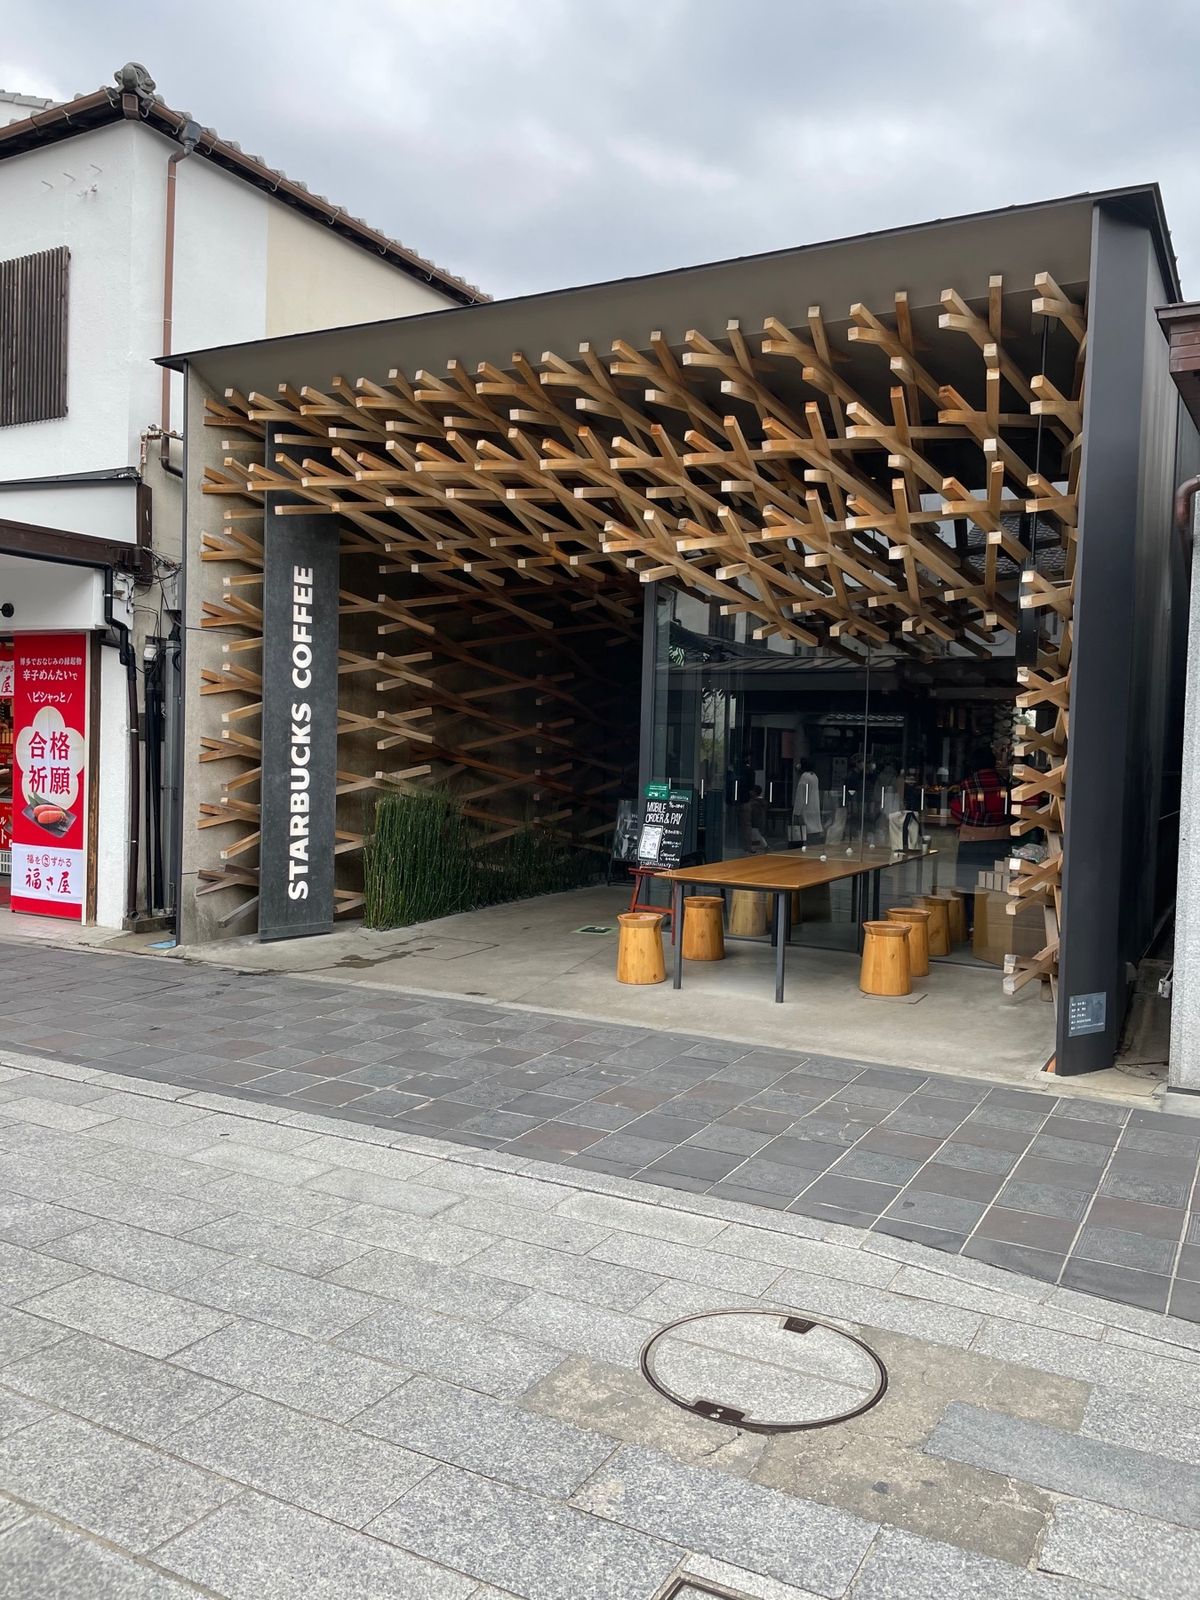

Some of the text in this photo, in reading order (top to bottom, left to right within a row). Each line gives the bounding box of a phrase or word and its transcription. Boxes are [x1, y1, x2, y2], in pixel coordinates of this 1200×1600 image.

[22, 669, 78, 681] 辛子めんたいで
[28, 731, 70, 760] 合格
[288, 566, 313, 900] STARBUCKS COFFEE
[28, 765, 70, 795] 祈願
[645, 813, 664, 823] ORDER
[670, 813, 683, 825] PAY
[646, 802, 666, 813] MOBILE
[25, 868, 71, 894] 福さ屋
